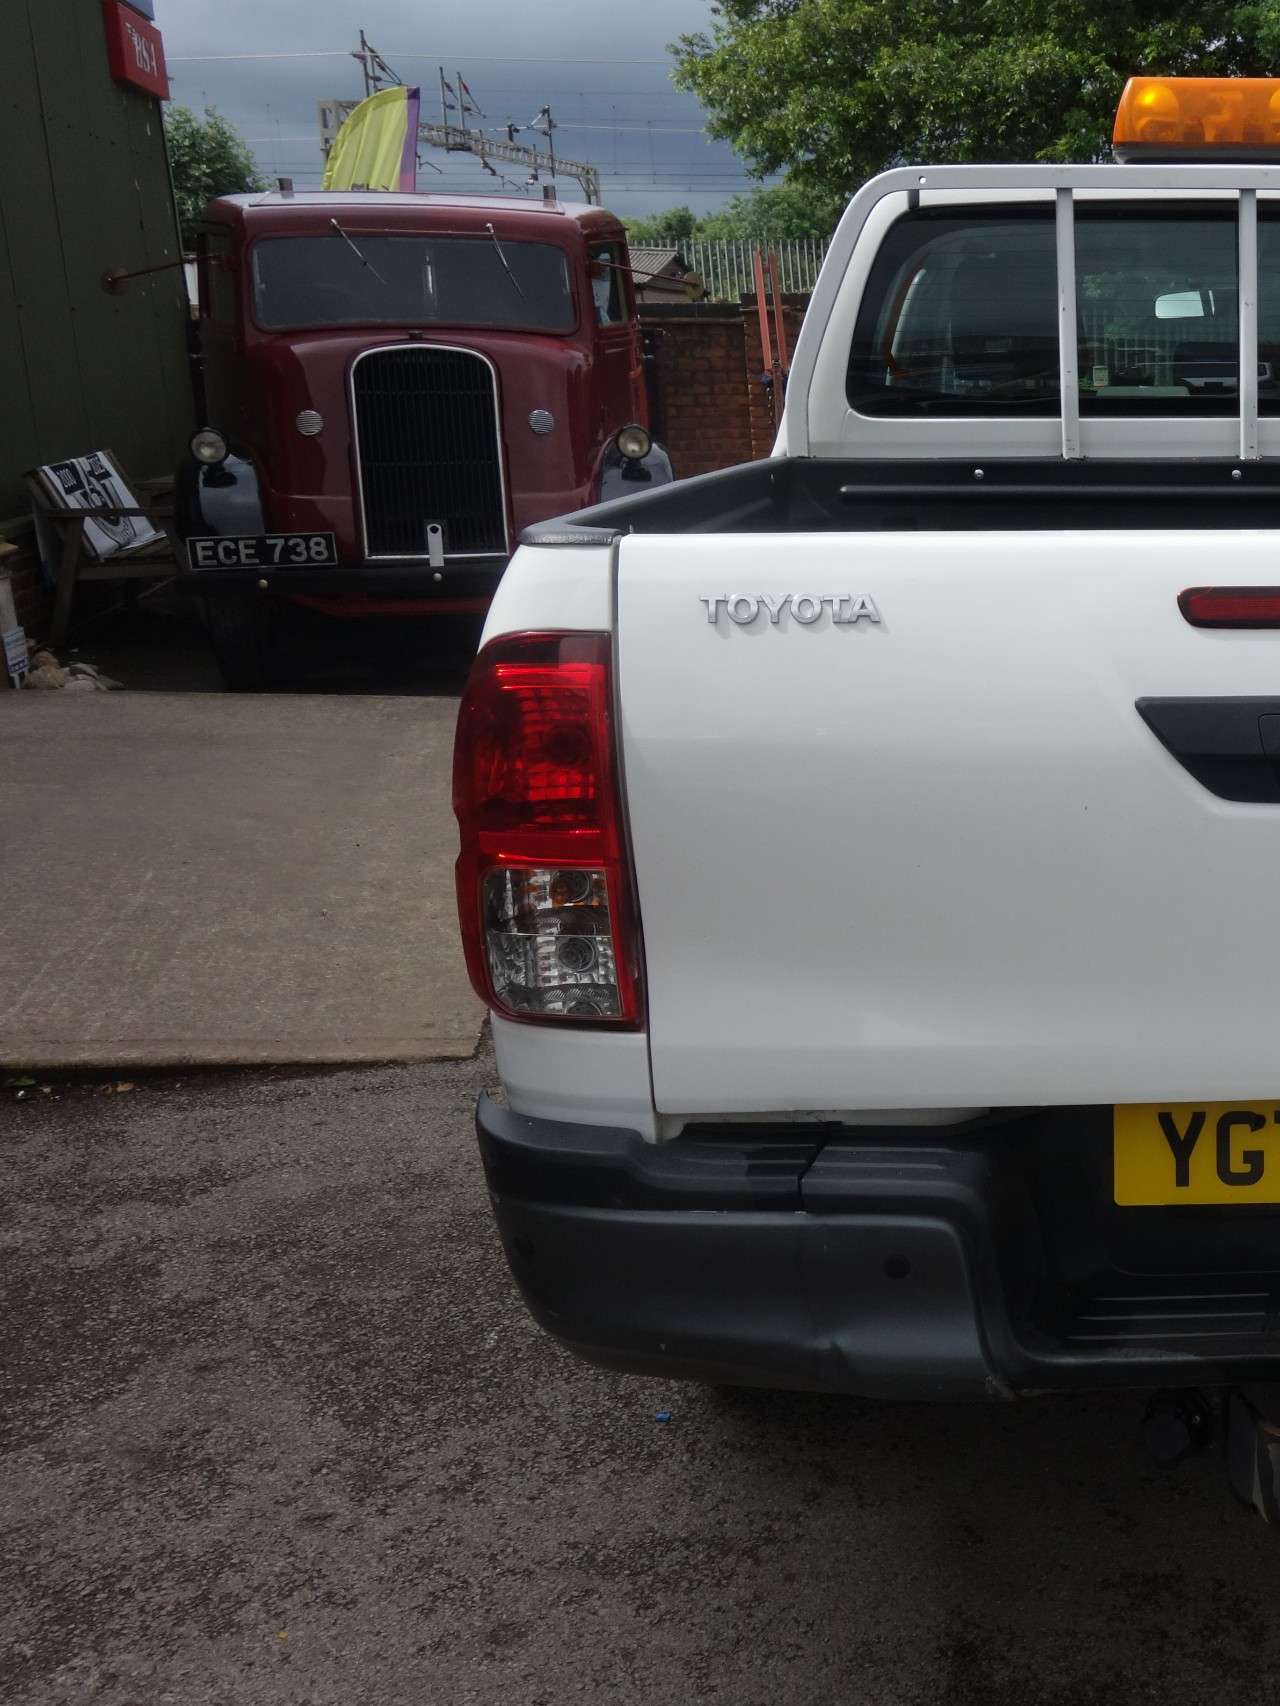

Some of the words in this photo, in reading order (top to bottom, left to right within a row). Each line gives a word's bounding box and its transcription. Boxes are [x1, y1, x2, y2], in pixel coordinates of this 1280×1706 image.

[195, 540, 260, 566] ECE
[266, 537, 329, 563] 738
[700, 592, 881, 624] TOYOTA
